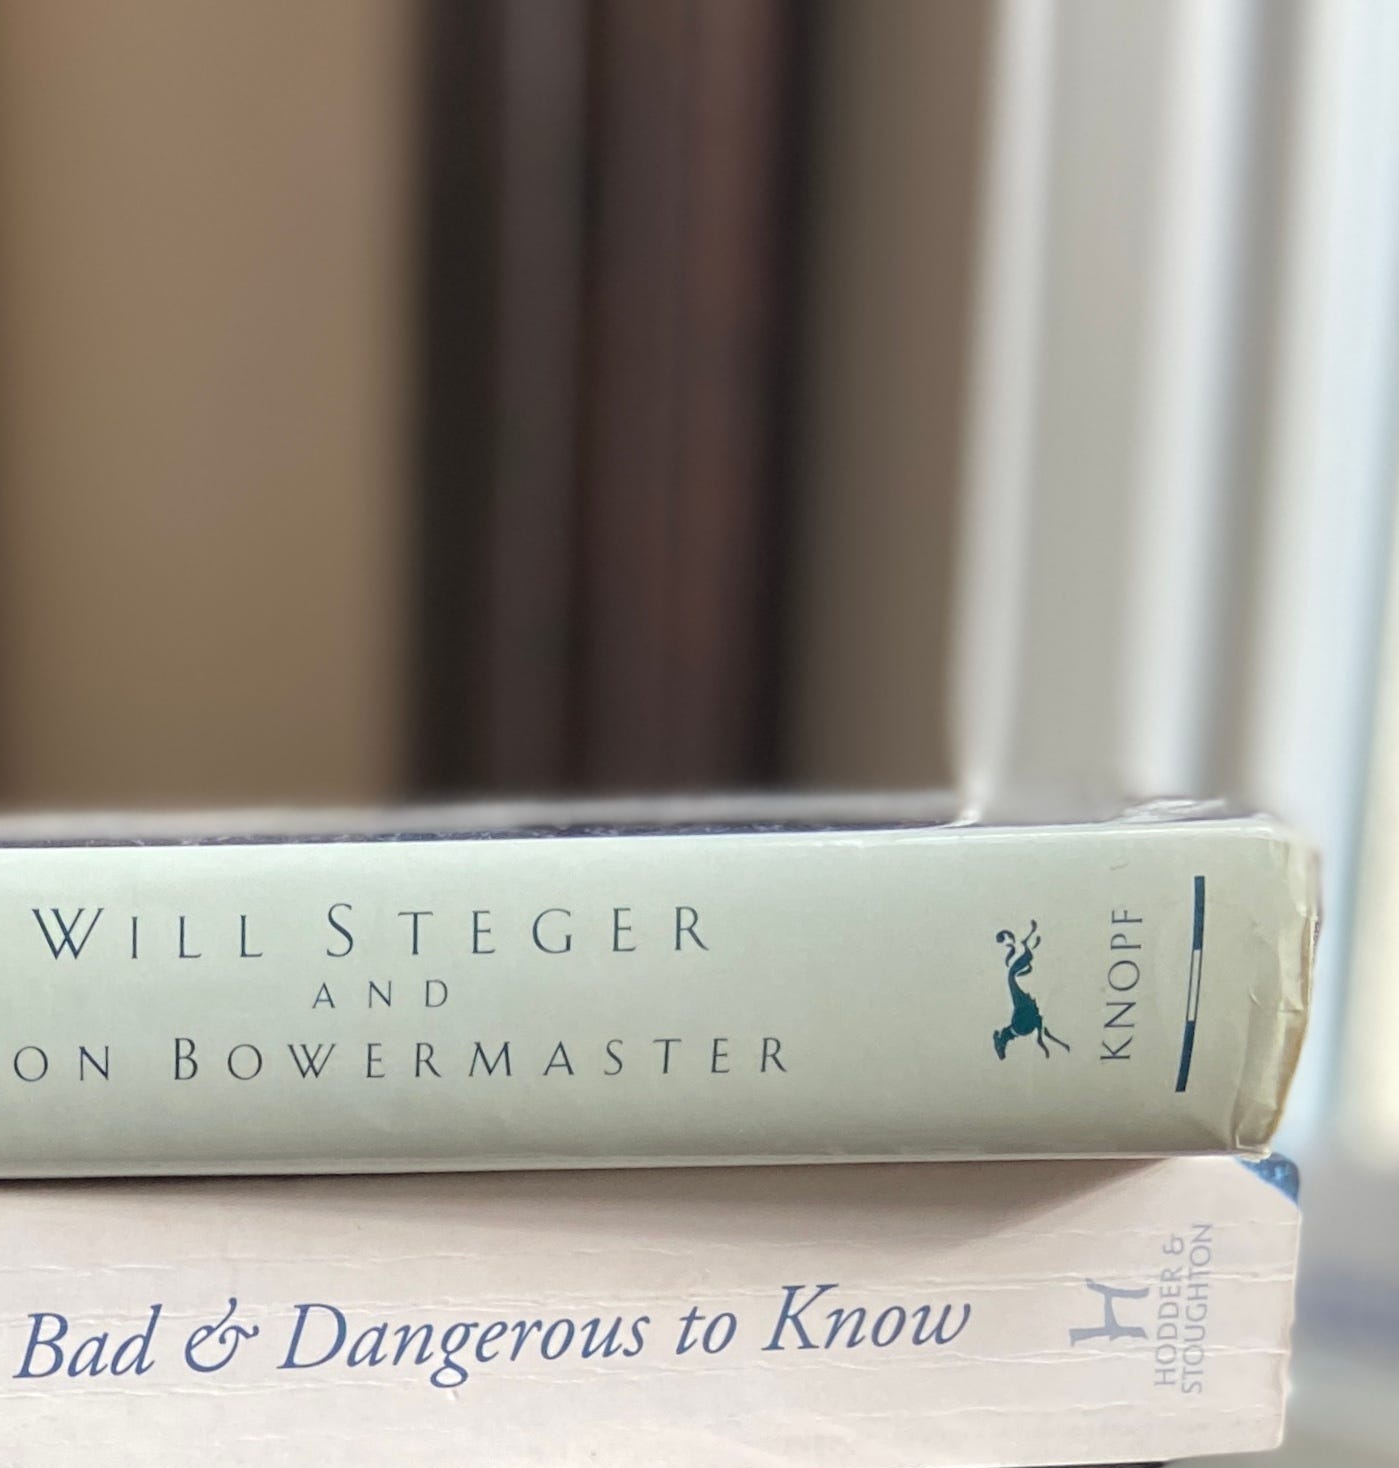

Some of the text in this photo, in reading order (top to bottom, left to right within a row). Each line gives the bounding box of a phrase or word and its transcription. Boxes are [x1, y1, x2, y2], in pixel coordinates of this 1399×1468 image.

[32, 904, 709, 960] WILL STEGER
[312, 980, 448, 1008] AND
[1100, 911, 1142, 1060] KNOPF
[175, 1038, 786, 1080] BOWERMASTER
[13, 1304, 162, 1378] Bad
[185, 1297, 259, 1372] &
[277, 1304, 650, 1388] Dangerous
[676, 1306, 737, 1355] to
[762, 1284, 971, 1350] Know
[1153, 1233, 1185, 1386] HODDER &
[1180, 1223, 1214, 1394] STOUGHTON
